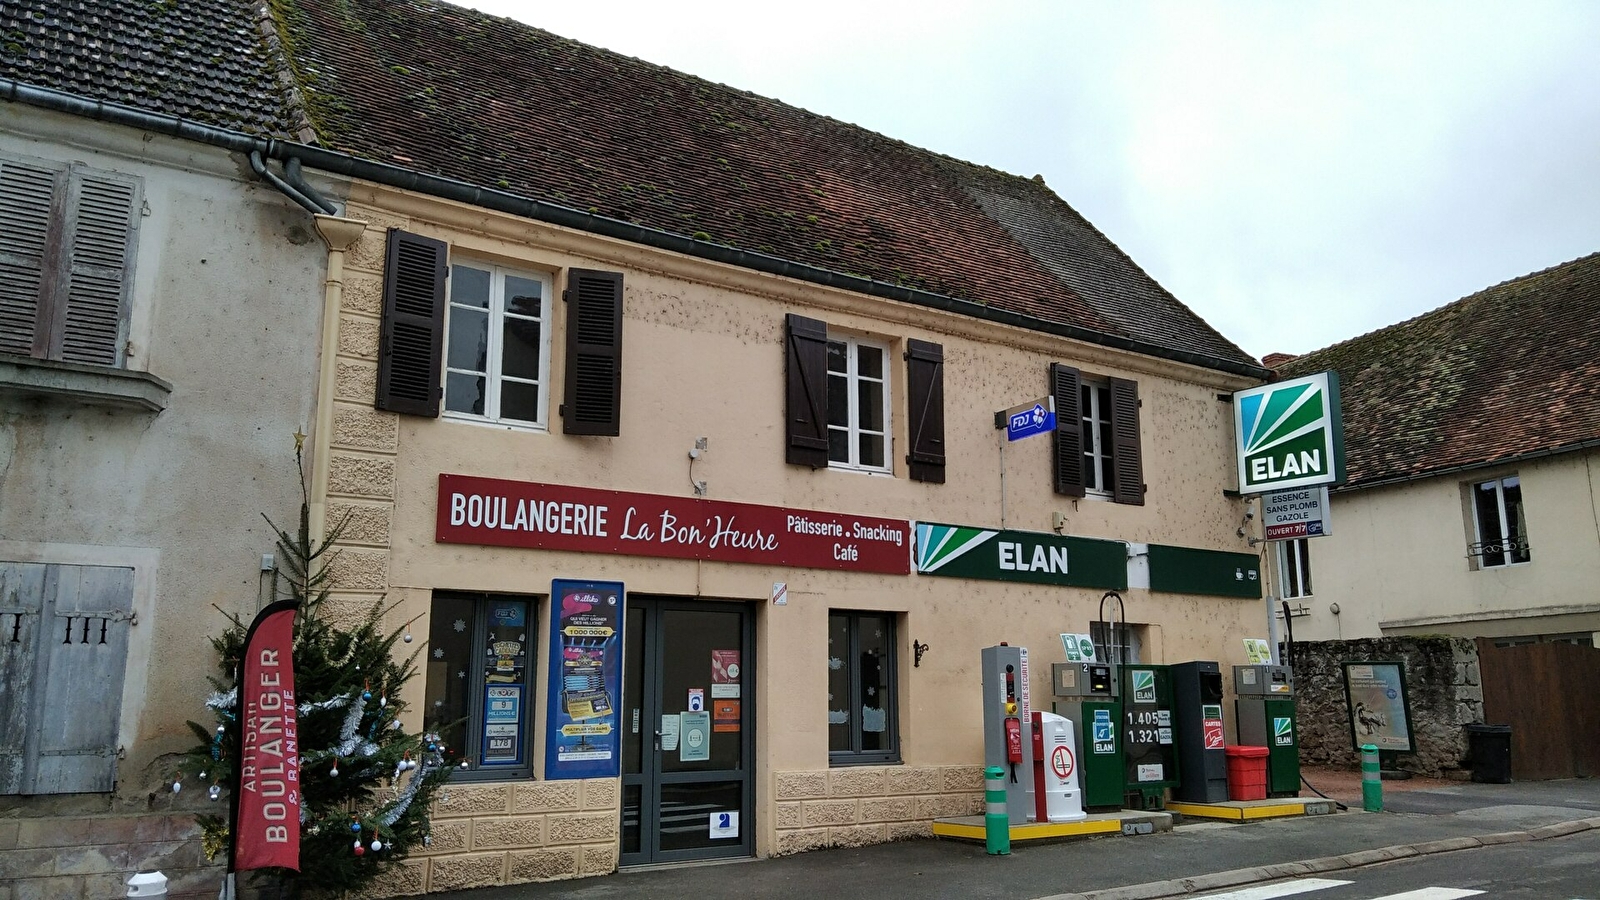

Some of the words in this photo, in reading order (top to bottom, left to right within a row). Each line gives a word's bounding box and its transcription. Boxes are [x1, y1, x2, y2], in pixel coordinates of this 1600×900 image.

[1012, 414, 1030, 429] FDJ
[1251, 449, 1321, 482] ELAN
[1272, 491, 1310, 503] ESSENCE
[1266, 504, 1289, 514] SANS
[1289, 500, 1318, 511] PLOMB
[450, 492, 608, 537] BOULANGERIE
[620, 506, 655, 541] La
[659, 509, 779, 551] Bon'Heure
[1276, 511, 1309, 522] GAZOLE
[787, 515, 843, 537] Pâtisserie
[853, 522, 903, 547] Snacking
[1267, 526, 1294, 536] OUVERT
[1294, 524, 1306, 534] 7/7
[833, 543, 859, 562] Café
[998, 541, 1069, 575] ELAN
[1082, 663, 1088, 673] 2
[1022, 690, 1029, 701] DE
[1136, 691, 1153, 699] ELAN
[1022, 701, 1030, 724] BORNE
[1127, 712, 1159, 725] 1.405
[1128, 729, 1160, 743] 1.321
[1277, 736, 1291, 744] ELAN
[259, 648, 289, 844] BOULANGER
[494, 739, 509, 747] 178
[1095, 743, 1113, 752] ELAN
